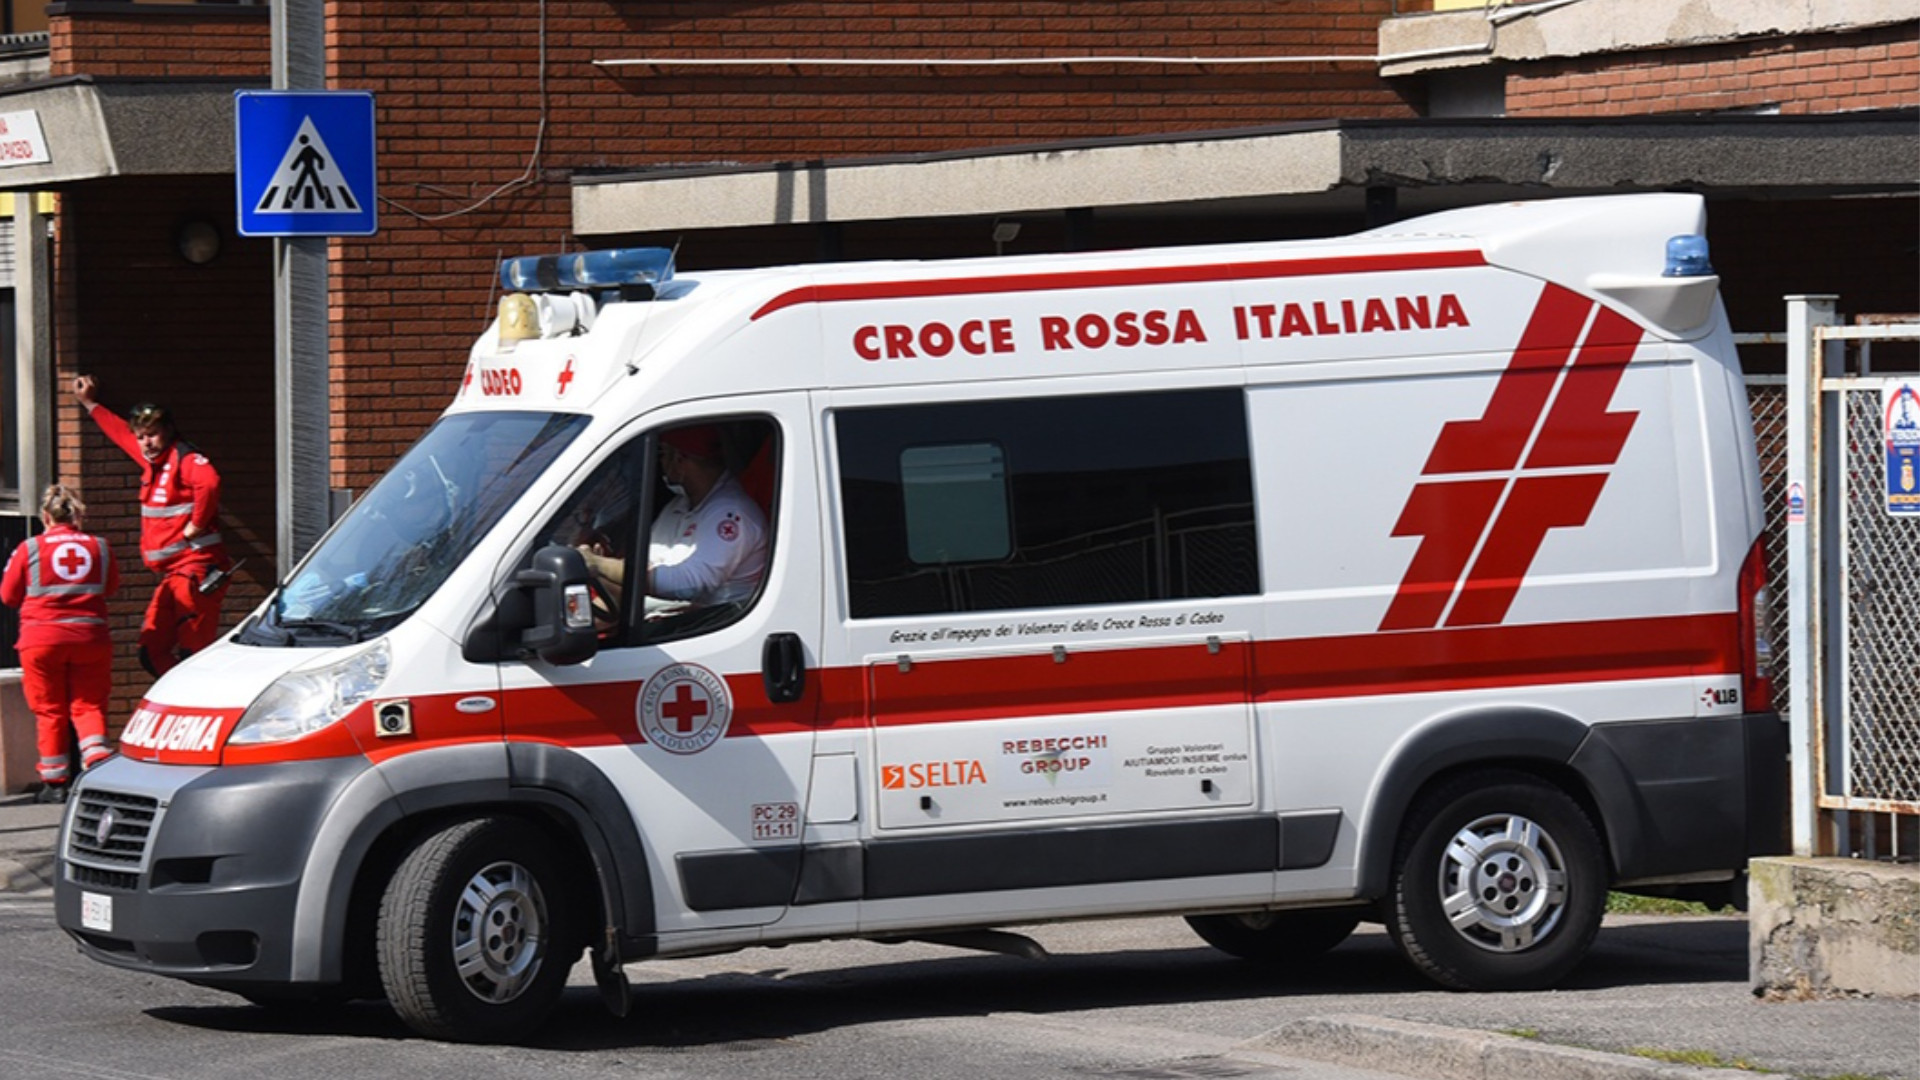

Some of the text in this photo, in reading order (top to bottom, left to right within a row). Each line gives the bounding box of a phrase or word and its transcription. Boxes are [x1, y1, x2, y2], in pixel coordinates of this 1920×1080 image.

[853, 293, 1470, 361] CROCE ROSSA ITALIANA
[481, 368, 522, 396] CADEO
[889, 630, 927, 644] Grazie
[995, 624, 1013, 637] dei
[1018, 620, 1068, 635] Volontari
[1071, 618, 1099, 633] della
[1102, 617, 1135, 631] Croce
[1138, 615, 1171, 628] Rossa
[1174, 613, 1188, 626] di
[1190, 611, 1225, 625] Cadeo
[1715, 688, 1738, 705] 118
[1003, 734, 1108, 754] REBECCHI
[1146, 743, 1224, 756] Gruppo Volontari
[1021, 756, 1091, 774] GROUP
[1123, 752, 1248, 767] AIUTIAMOCI INSIEME onlus
[909, 759, 987, 788] SELTA
[1145, 764, 1228, 777] Roveleto di Cadeo
[1003, 793, 1107, 809] www.rebecchigroup.it
[754, 804, 796, 820] PC 29
[755, 823, 793, 837] 11-11
